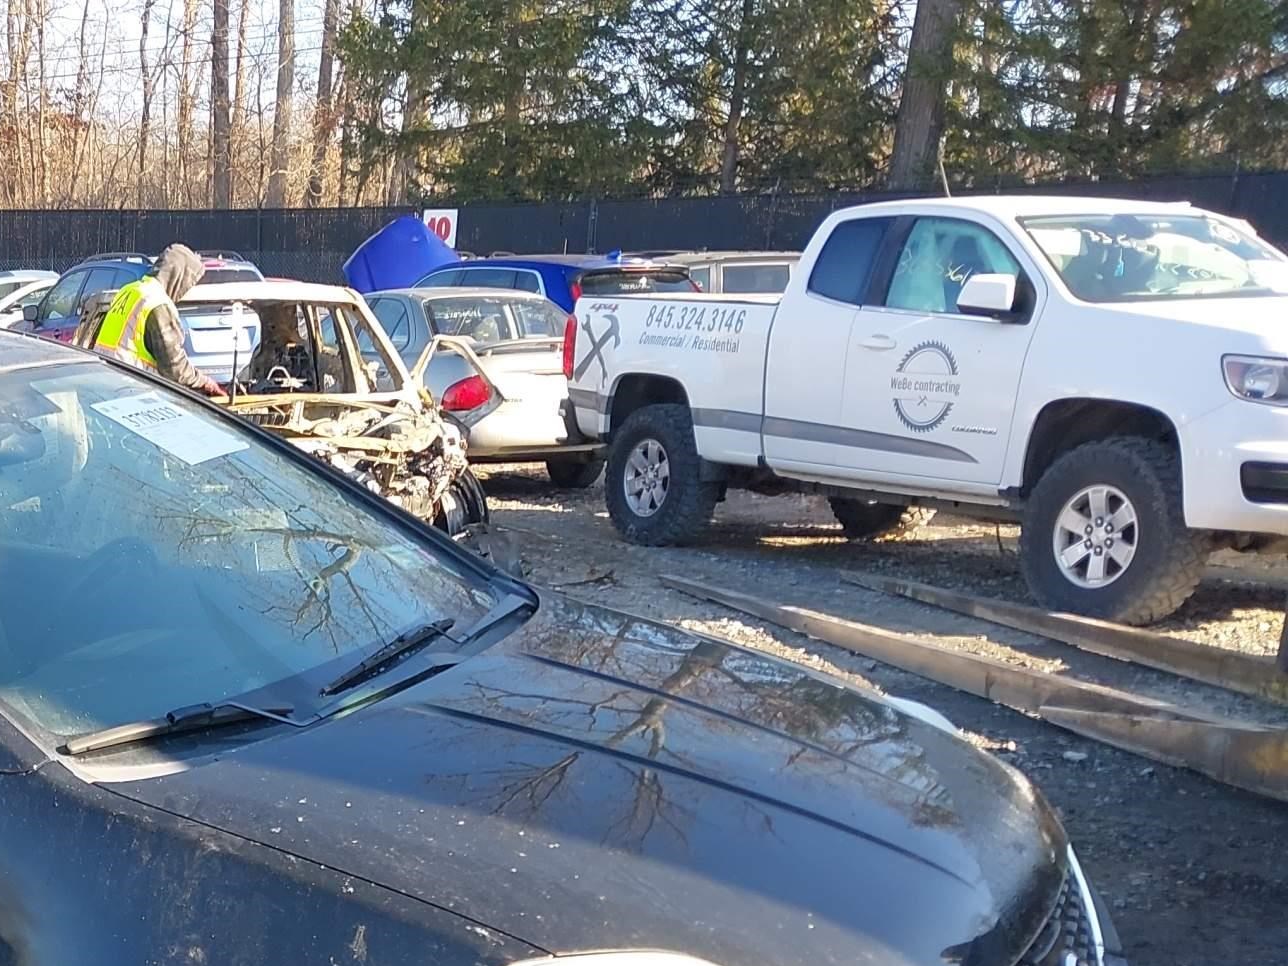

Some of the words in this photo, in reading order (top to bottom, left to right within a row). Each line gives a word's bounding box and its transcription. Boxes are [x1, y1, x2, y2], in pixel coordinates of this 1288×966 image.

[646, 305, 747, 334] 845.324.3146
[639, 331, 685, 349] Commercial
[692, 335, 740, 353] Residential
[890, 376, 913, 392] WeBe
[914, 380, 960, 396] contracting
